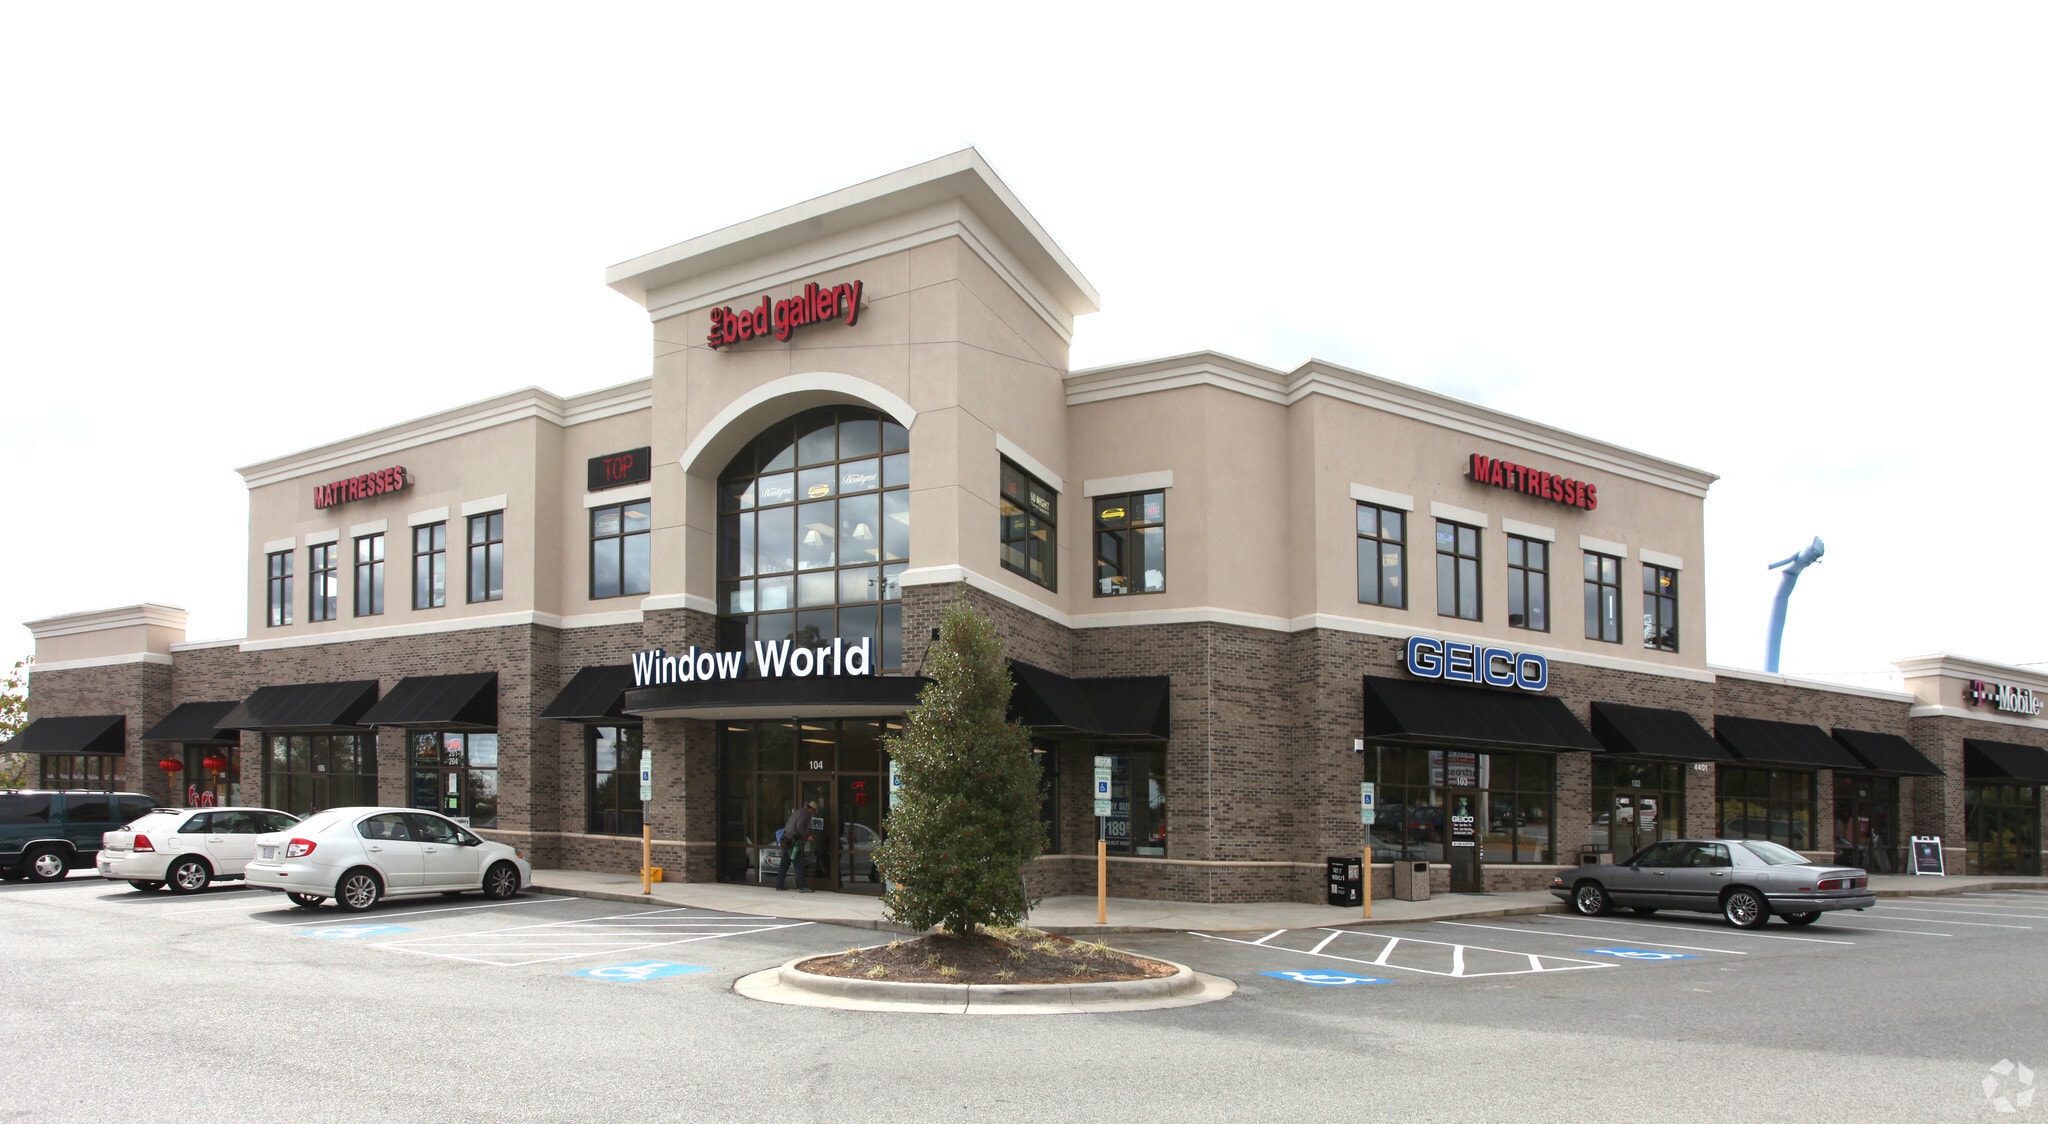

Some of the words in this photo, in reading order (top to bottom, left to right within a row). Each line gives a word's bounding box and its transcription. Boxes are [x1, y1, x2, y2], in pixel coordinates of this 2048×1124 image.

[723, 294, 769, 344] bed
[774, 279, 863, 342] gallery
[313, 465, 405, 510] MATTRESSES
[603, 454, 634, 481] TOP
[1471, 453, 1598, 511] MATTRESSES
[632, 645, 743, 687] Window
[754, 636, 873, 678] World
[1408, 635, 1549, 691] GEICO
[809, 760, 823, 769] 104
[1457, 777, 1468, 786] 103
[1694, 763, 1708, 771] 4401
